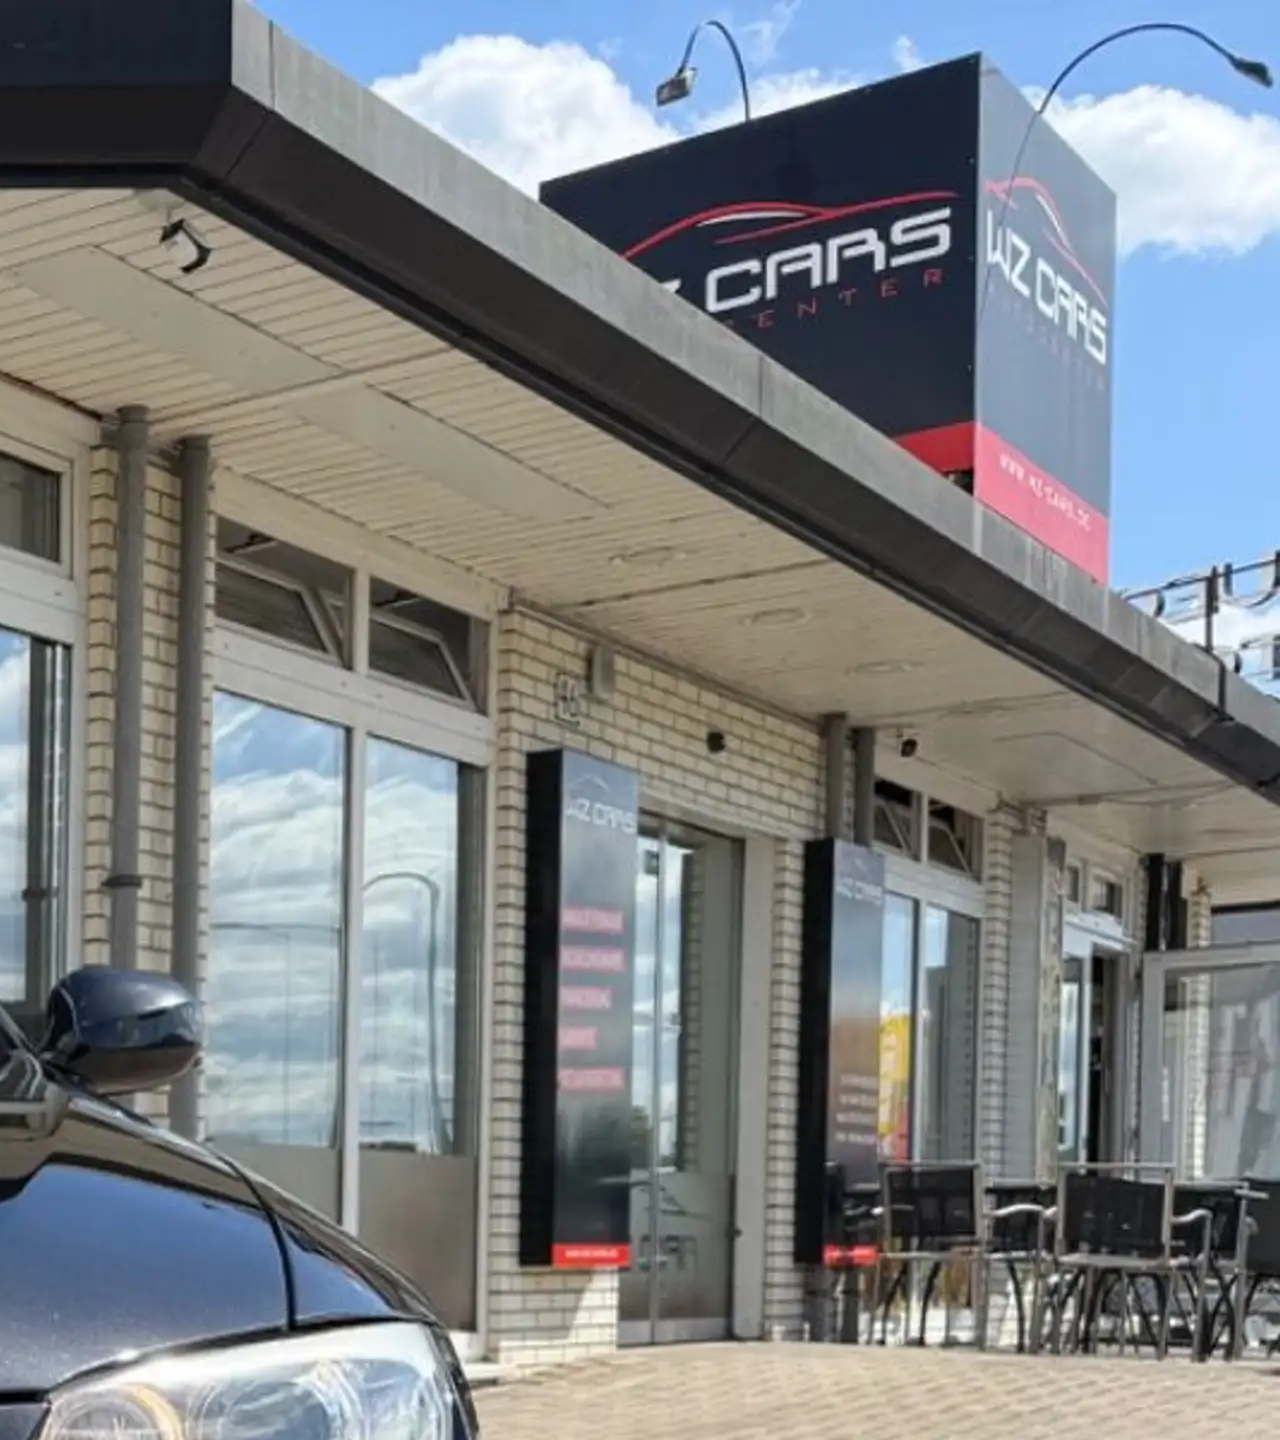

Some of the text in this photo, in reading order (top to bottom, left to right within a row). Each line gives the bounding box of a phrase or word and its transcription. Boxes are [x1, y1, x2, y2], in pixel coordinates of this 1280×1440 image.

[705, 207, 951, 314] CARS
[726, 267, 943, 328] ENTER
[986, 209, 1031, 299] WZ
[1035, 257, 1107, 366] CARS
